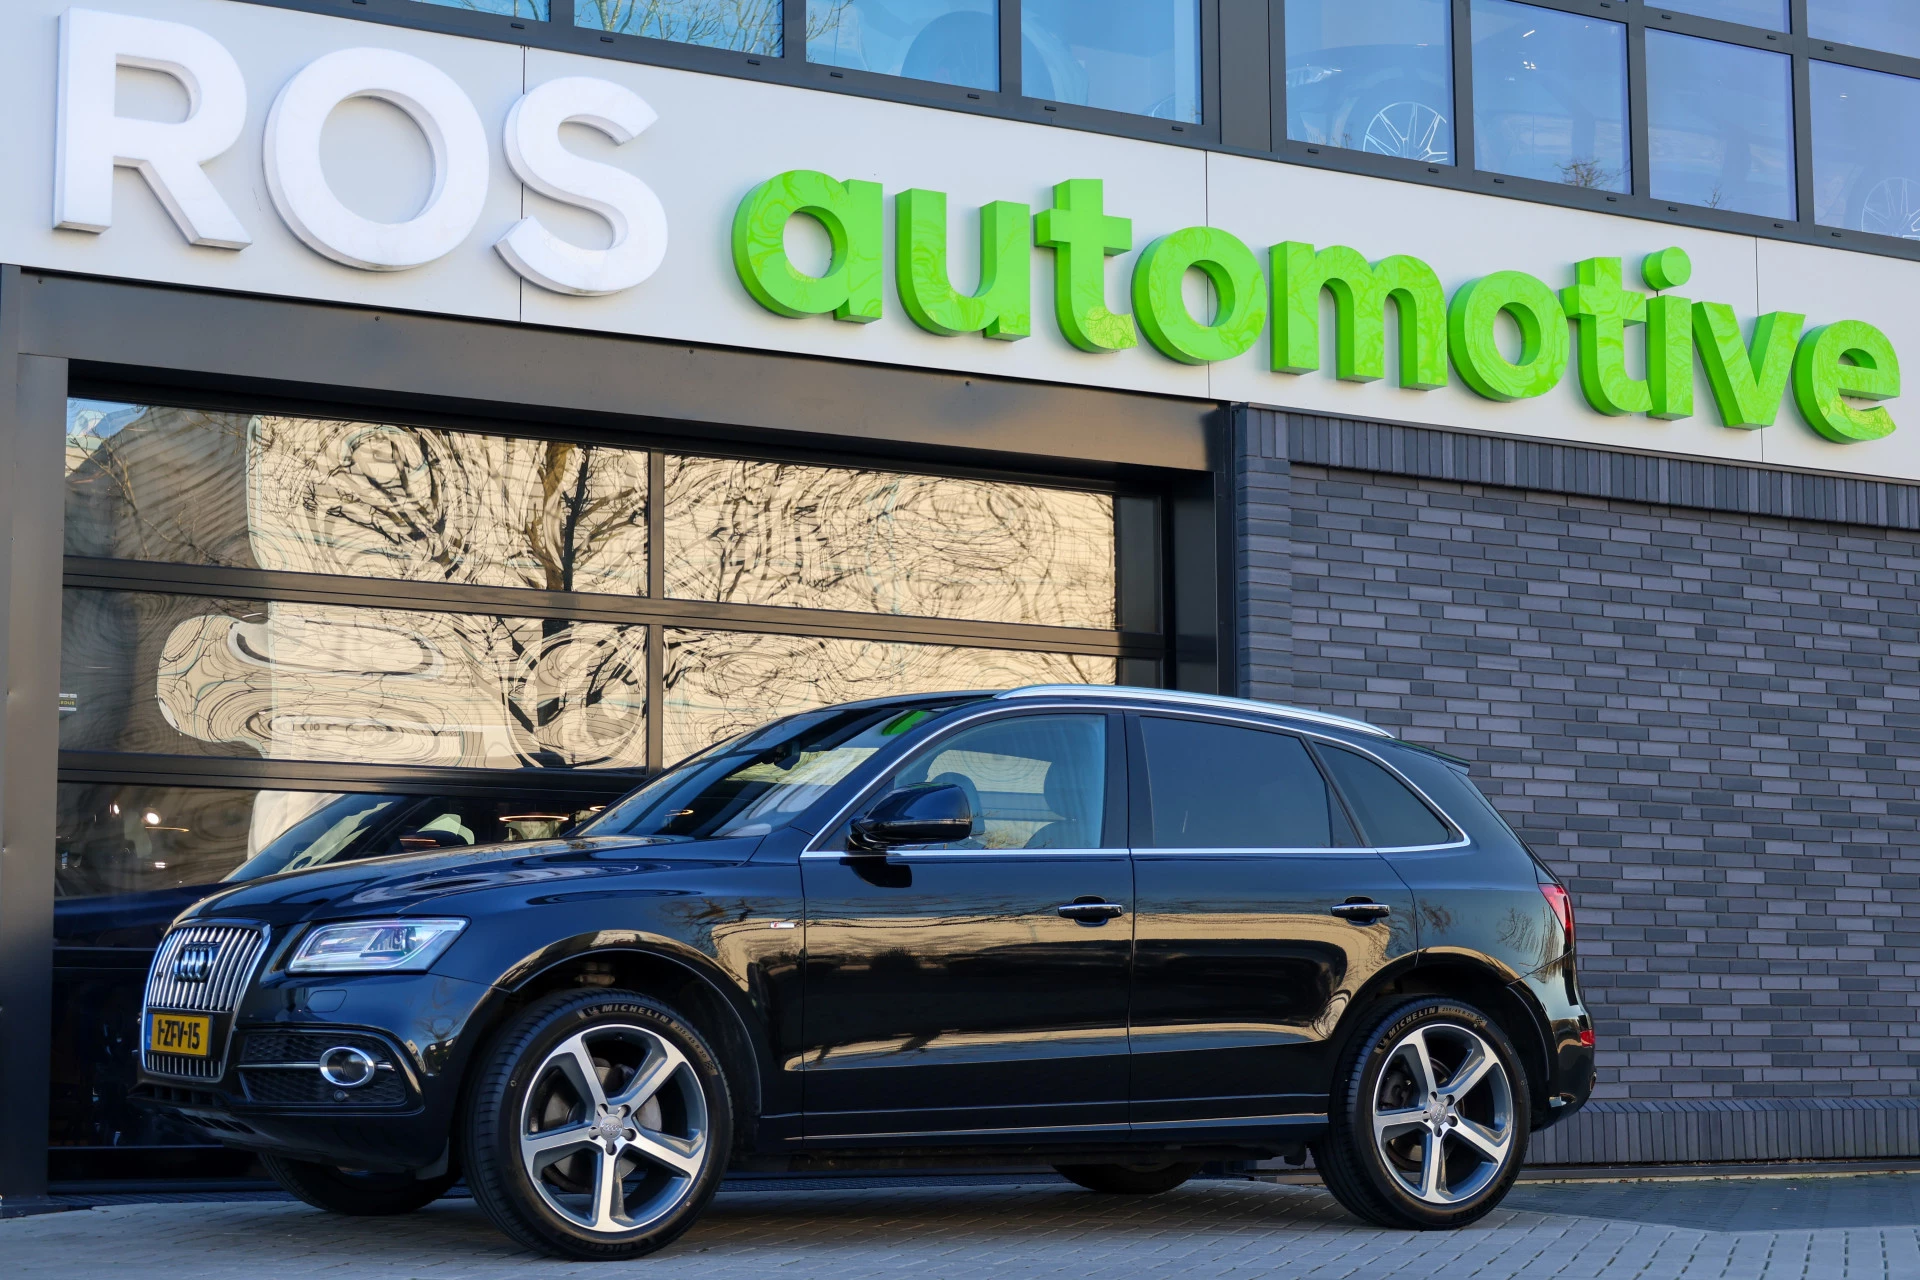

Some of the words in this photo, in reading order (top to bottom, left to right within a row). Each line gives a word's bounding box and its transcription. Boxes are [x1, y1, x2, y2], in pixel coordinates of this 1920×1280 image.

[52, 7, 668, 297] ROS
[731, 170, 1900, 445] automotive
[602, 1004, 669, 1023] MICHELIN
[1388, 1006, 1436, 1038] MICHELIN
[157, 1018, 200, 1049] 1-ZFV-15
